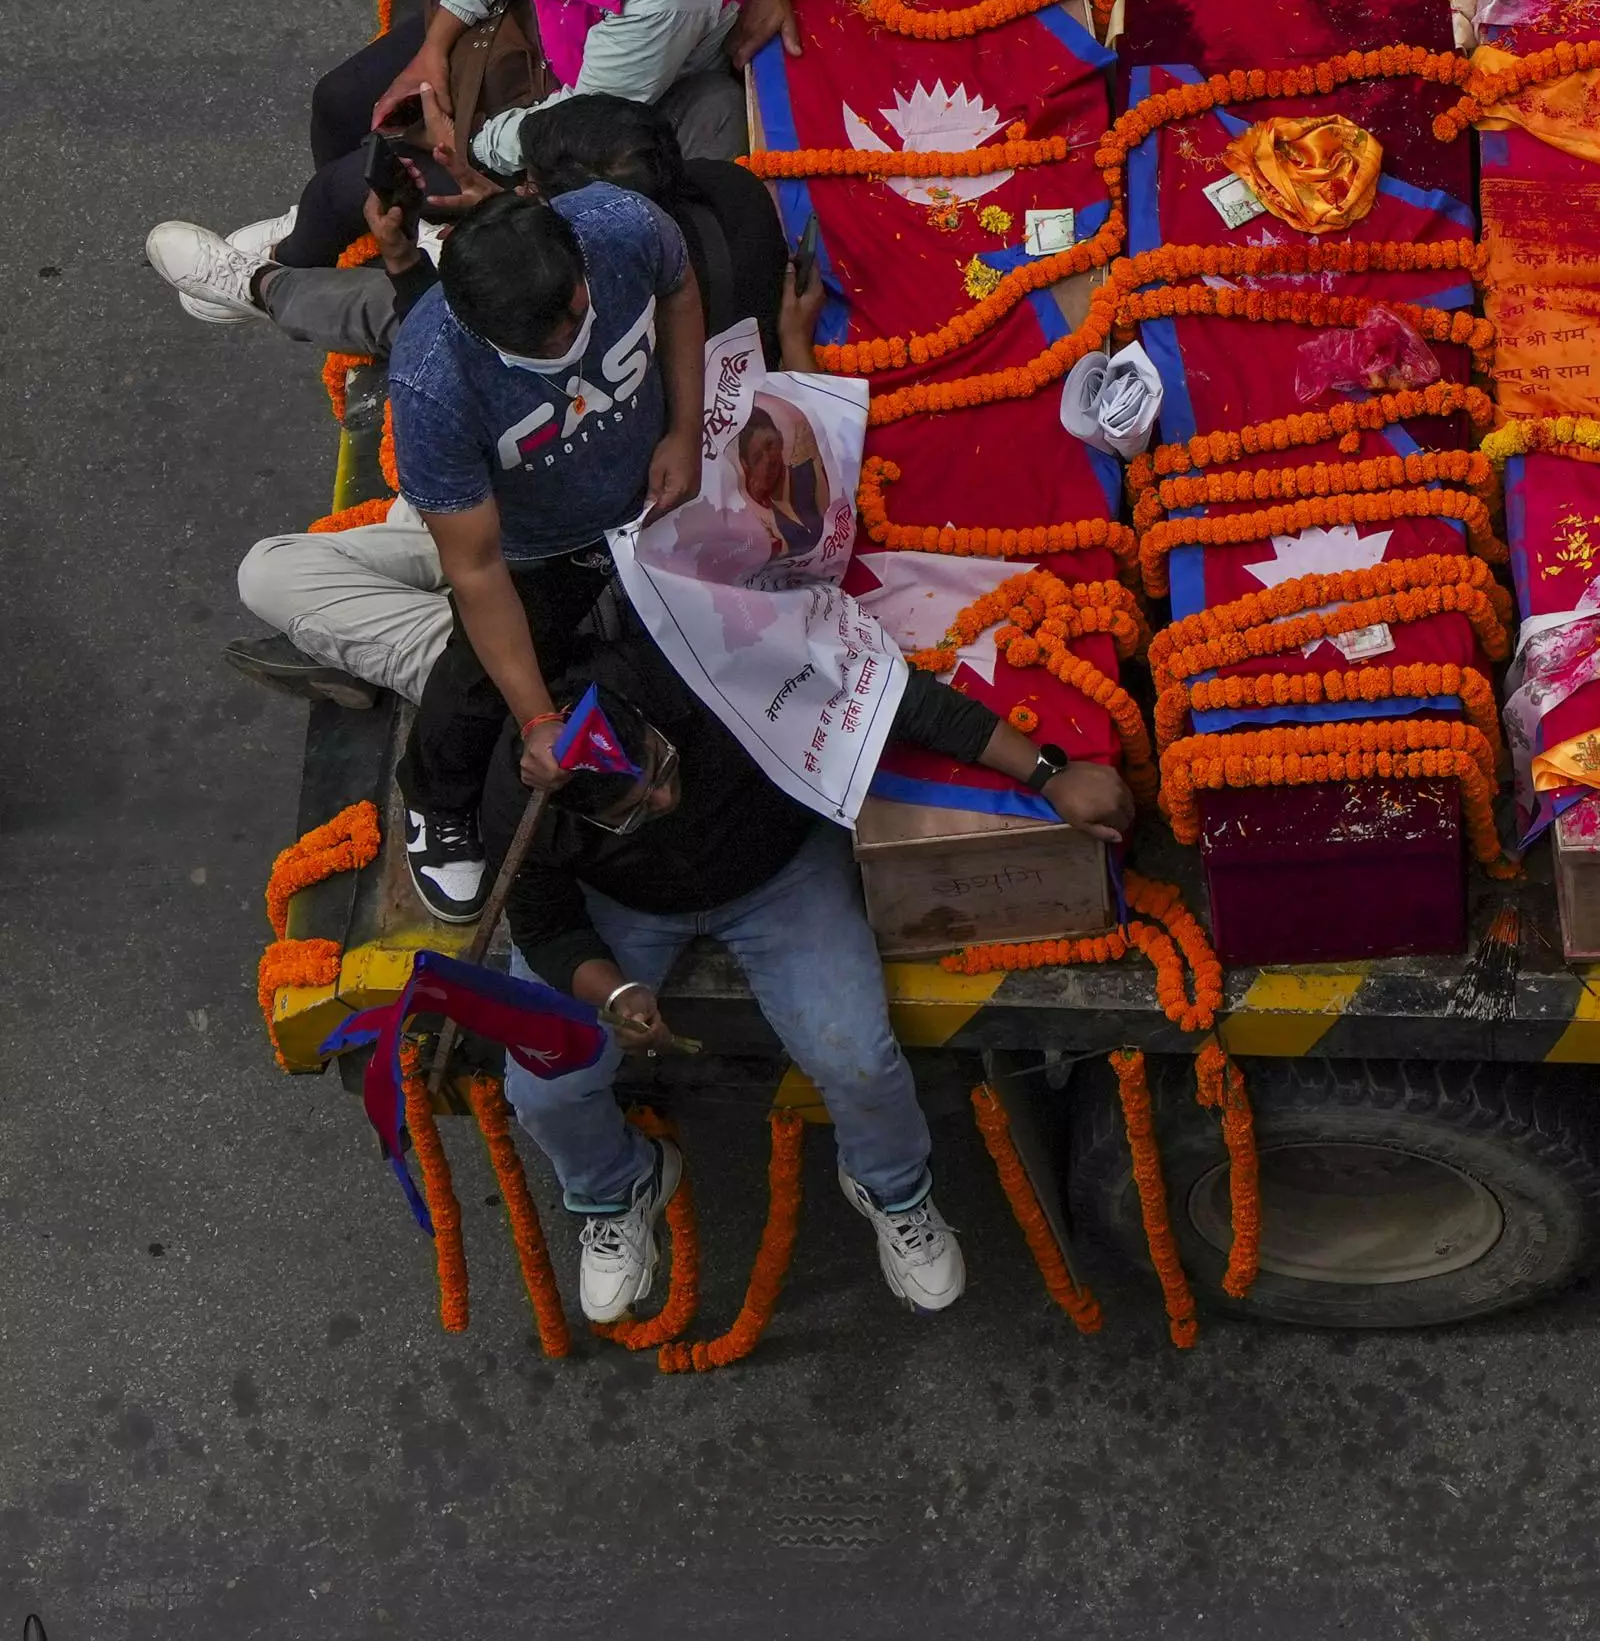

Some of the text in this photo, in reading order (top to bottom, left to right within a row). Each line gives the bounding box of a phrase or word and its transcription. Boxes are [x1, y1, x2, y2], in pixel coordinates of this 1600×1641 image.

[1526, 331, 1546, 347] श्री
[1552, 327, 1586, 344] राम
[1530, 366, 1550, 382] श्री
[1556, 364, 1590, 378] राम
[764, 664, 817, 723] नेपालीको
[854, 657, 878, 700] सम्मान
